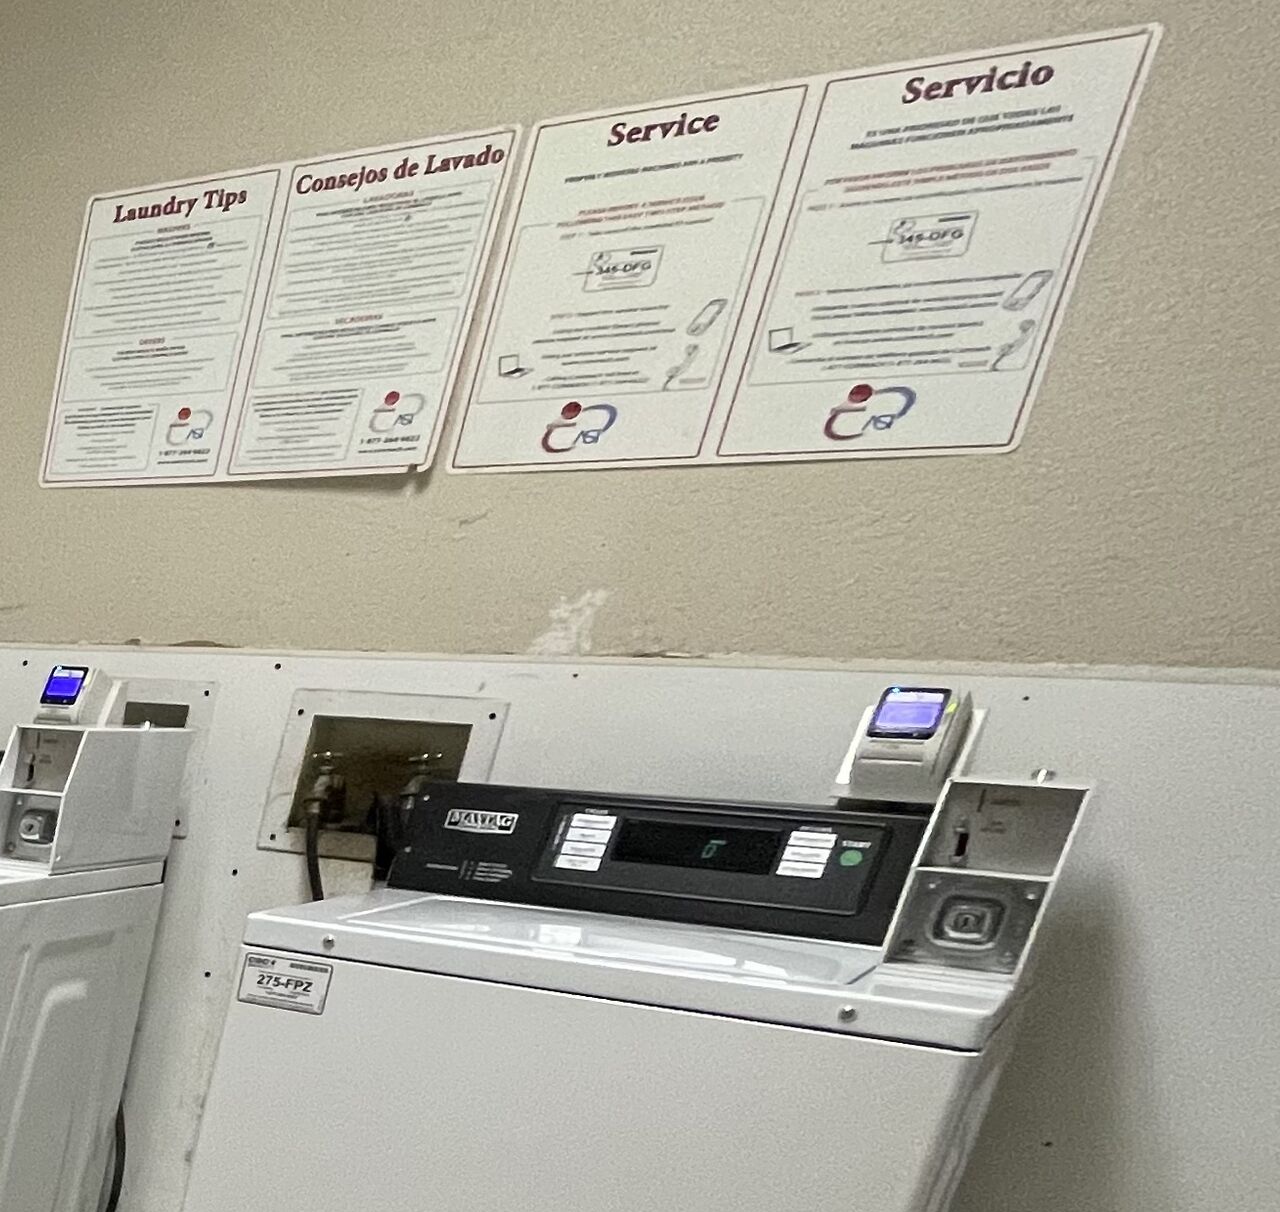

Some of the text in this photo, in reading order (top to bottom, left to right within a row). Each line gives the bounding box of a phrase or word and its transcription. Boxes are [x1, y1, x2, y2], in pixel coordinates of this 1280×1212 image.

[902, 60, 1055, 104] Servicio
[607, 110, 722, 147] Service
[296, 144, 505, 194] Consejos de Lavado
[113, 188, 248, 223] Laundry Tips
[257, 973, 313, 992] 275-FPZ
